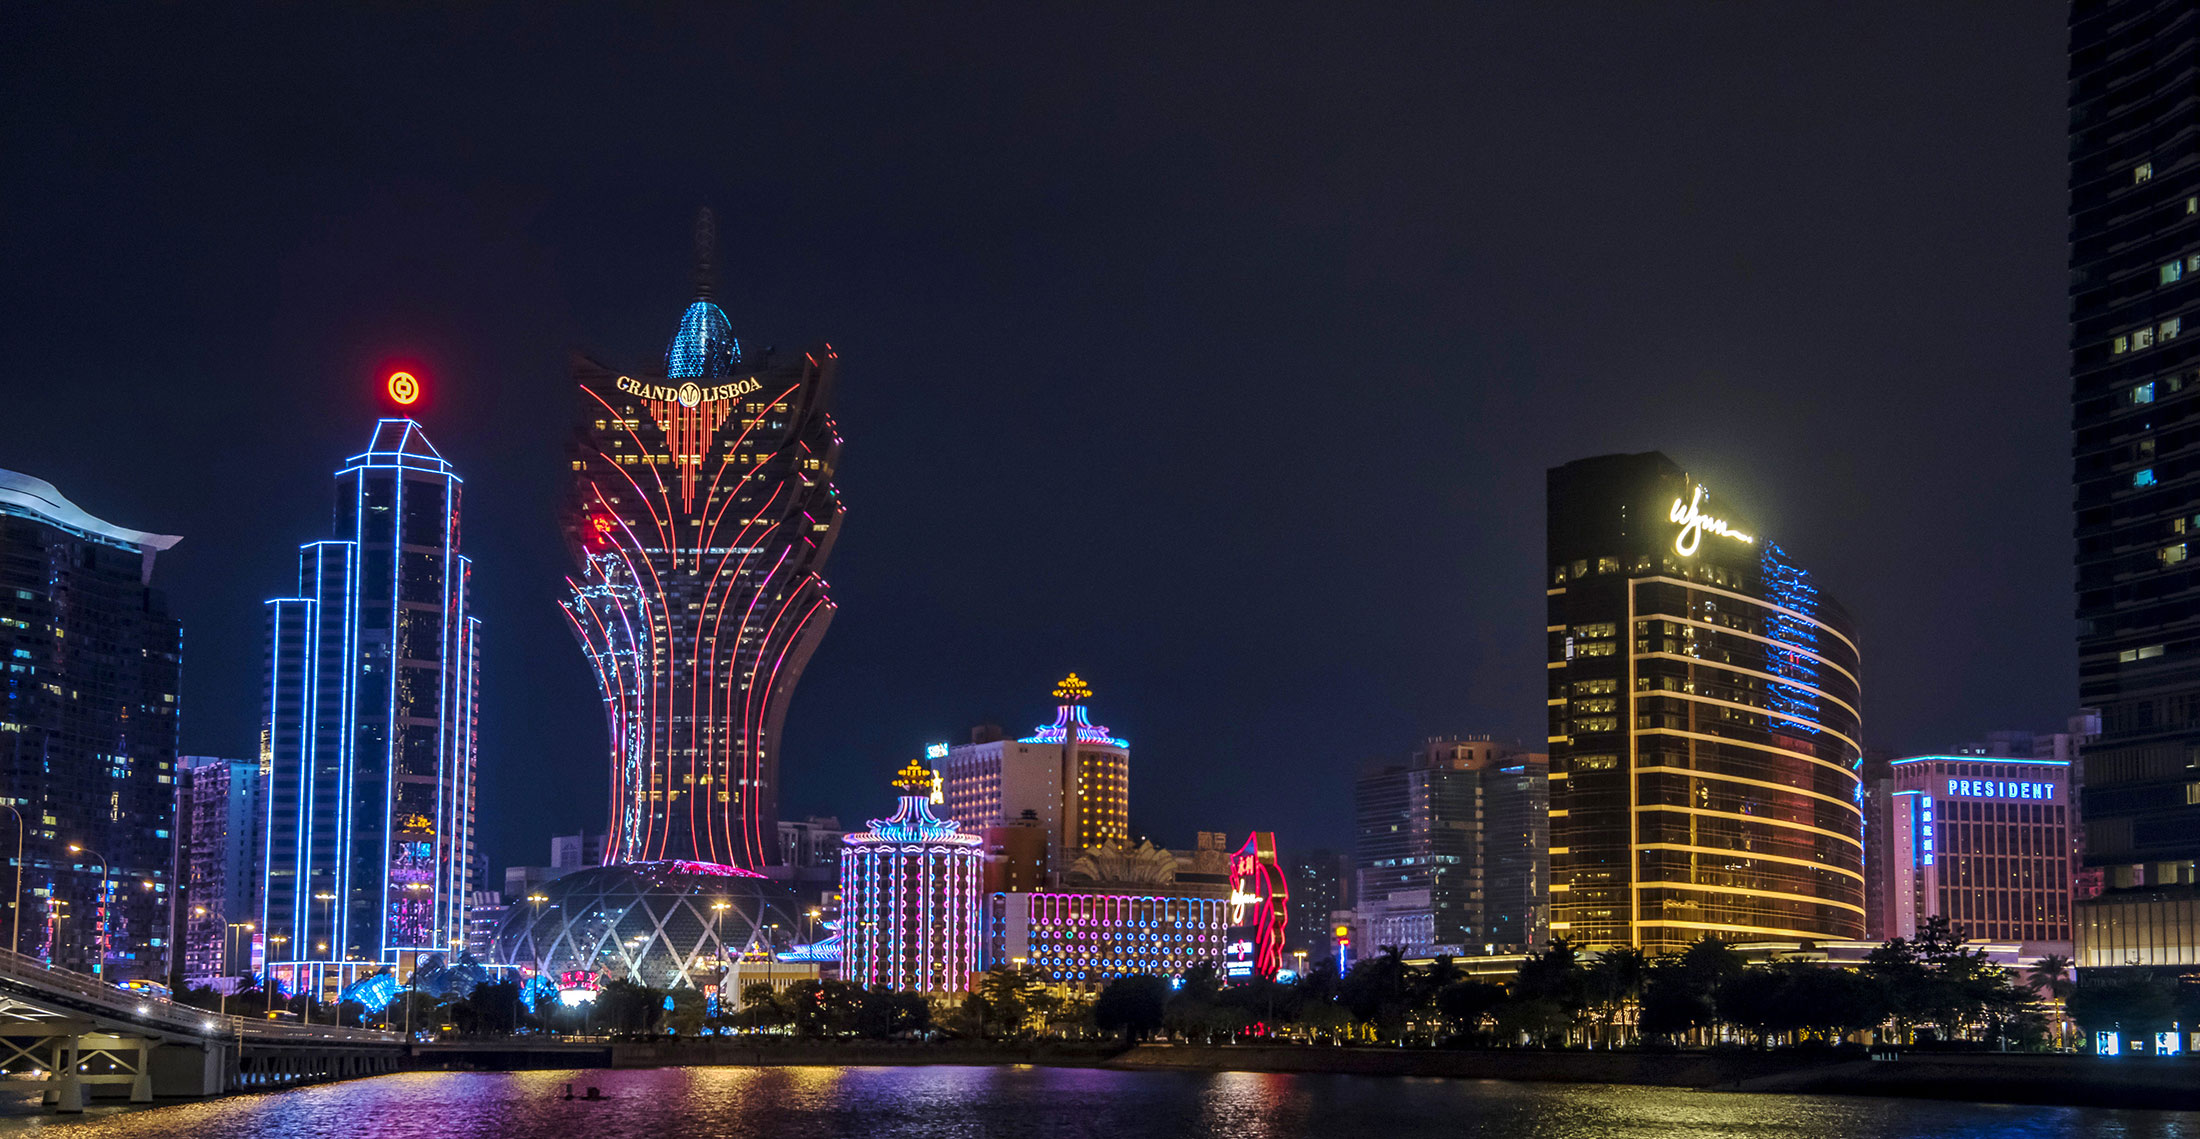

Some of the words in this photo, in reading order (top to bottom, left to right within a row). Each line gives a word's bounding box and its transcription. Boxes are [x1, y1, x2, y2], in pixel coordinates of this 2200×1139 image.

[617, 376, 678, 402] GRAND
[701, 376, 763, 402] LISBOA
[1948, 779, 2055, 800] PRESIDENT
